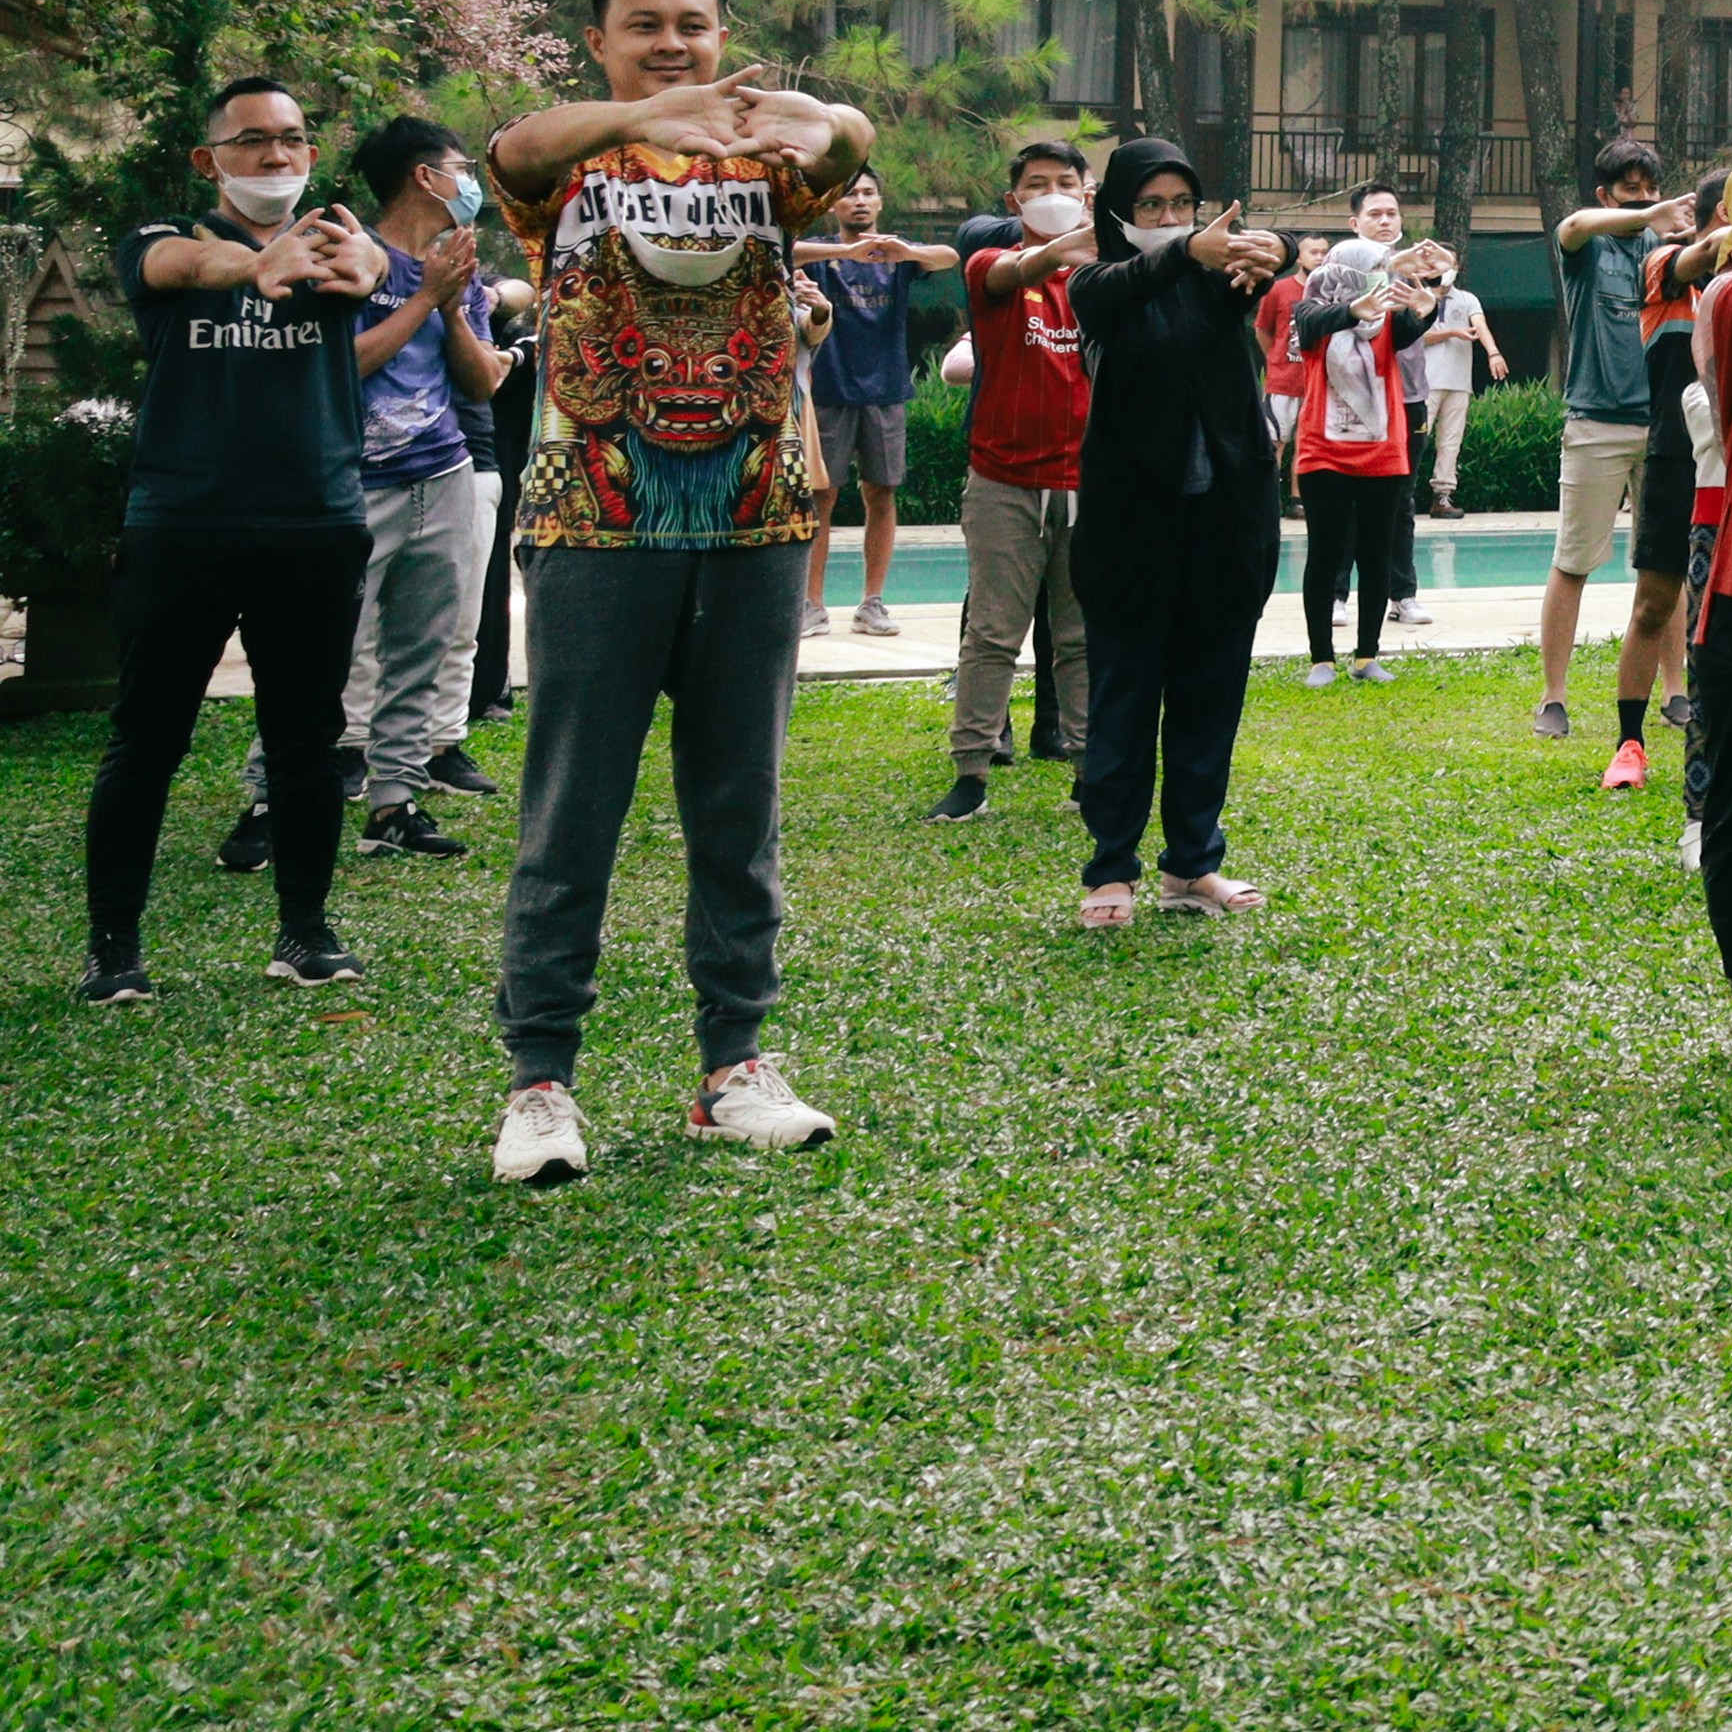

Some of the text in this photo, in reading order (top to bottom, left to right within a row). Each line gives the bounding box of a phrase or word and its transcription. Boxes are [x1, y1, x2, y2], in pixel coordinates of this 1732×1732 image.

[241, 295, 272, 323] Fly
[189, 318, 323, 350] Emirates
[1027, 316, 1080, 339] Stndar
[1025, 331, 1080, 354] Chartere
